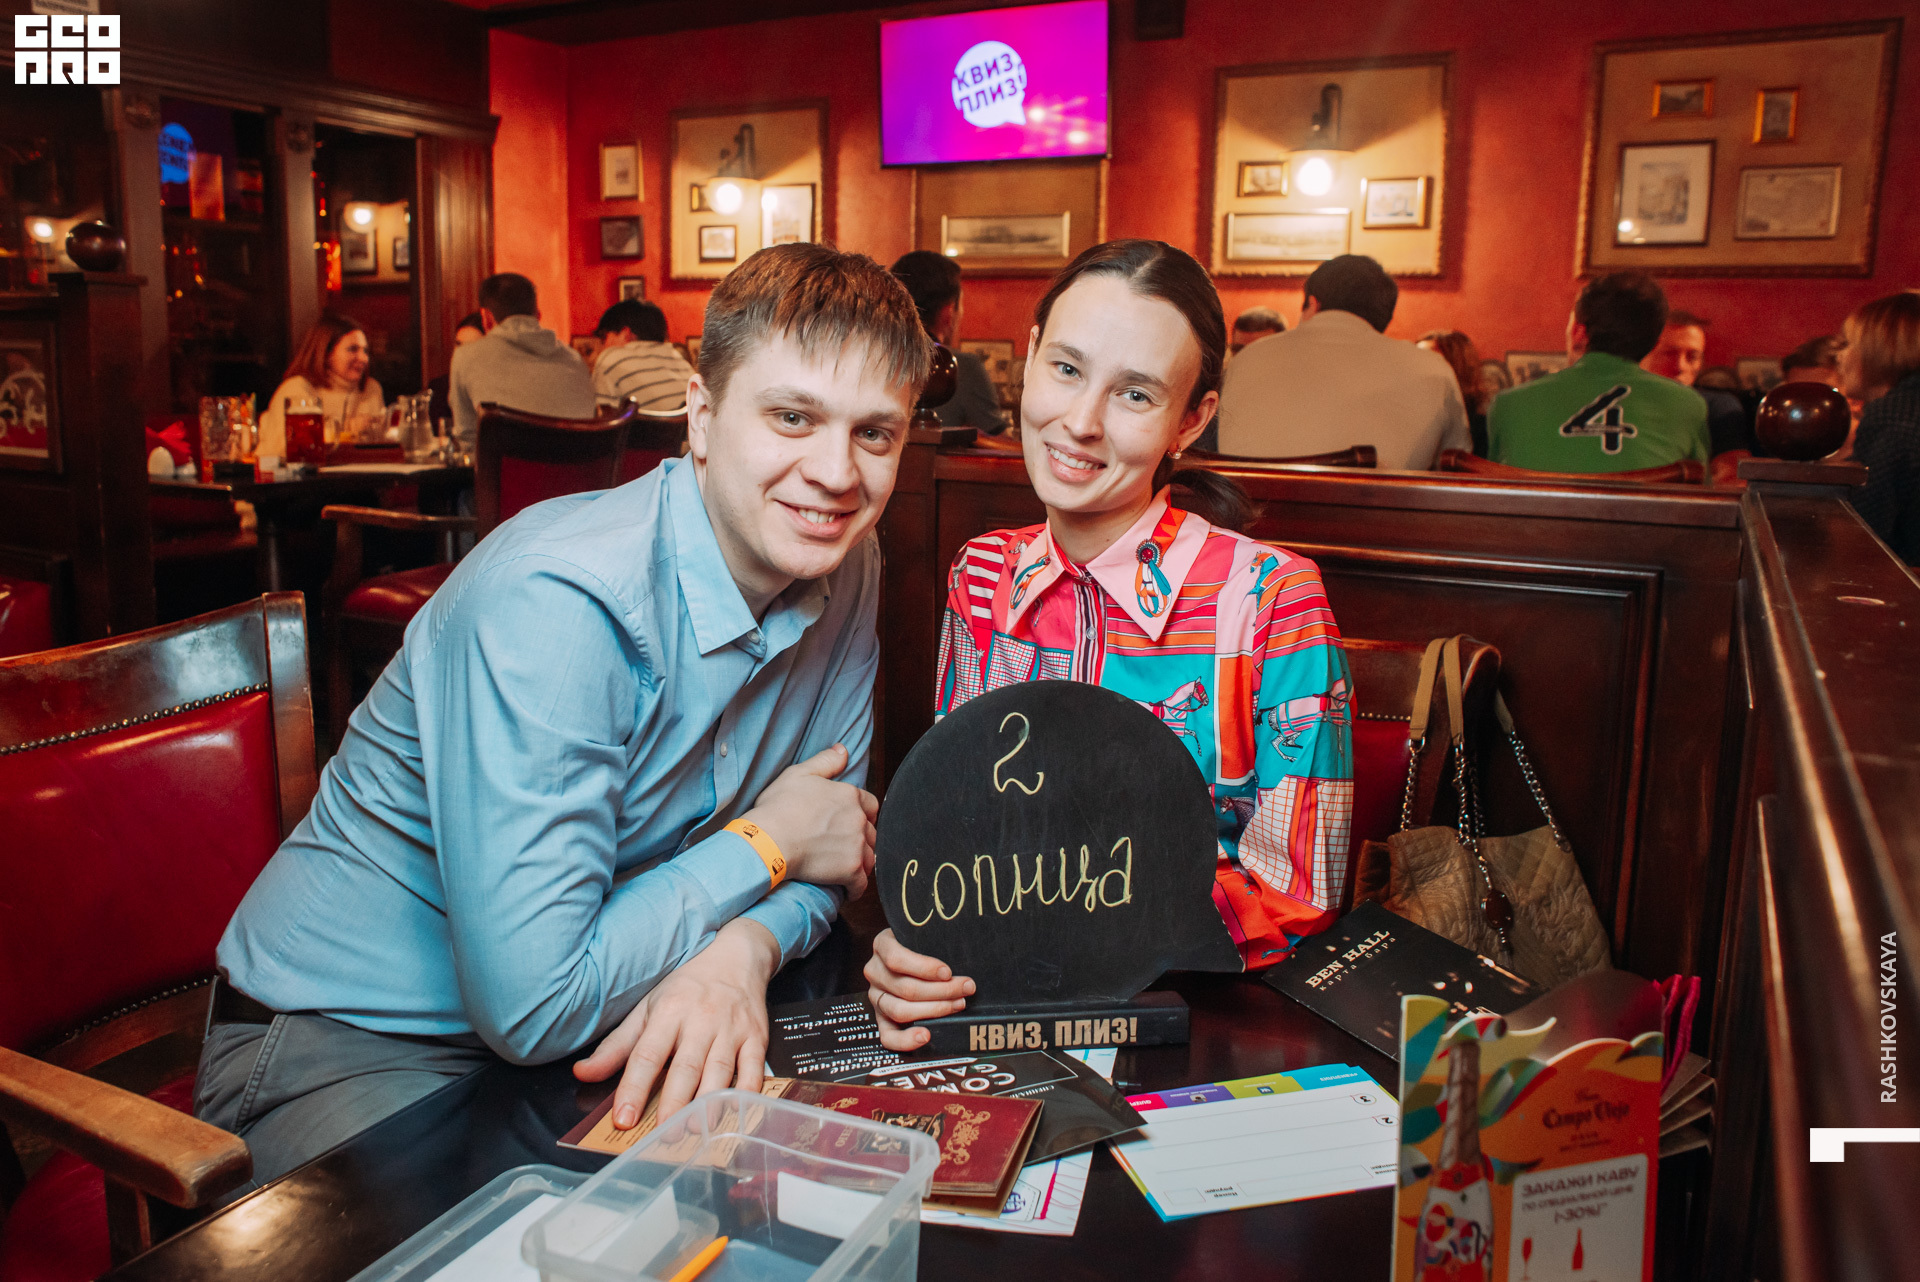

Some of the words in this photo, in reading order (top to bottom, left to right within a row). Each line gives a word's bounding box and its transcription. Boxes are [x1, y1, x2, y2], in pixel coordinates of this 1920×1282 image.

[1558, 384, 1638, 455] 4
[993, 711, 1045, 795] 2
[1305, 960, 1344, 988] BEN
[1342, 931, 1390, 962] HALL
[1319, 964, 1357, 991] карта
[1365, 937, 1396, 959] бара
[783, 1013, 870, 1030] Коктейль
[838, 1031, 880, 1042] Пиво
[969, 1021, 1048, 1051] КВИЗ,
[1055, 1016, 1138, 1047] ПЛИЗ!
[928, 1072, 1015, 1094] COM
[1522, 1174, 1592, 1197] ЗАКАЖИ
